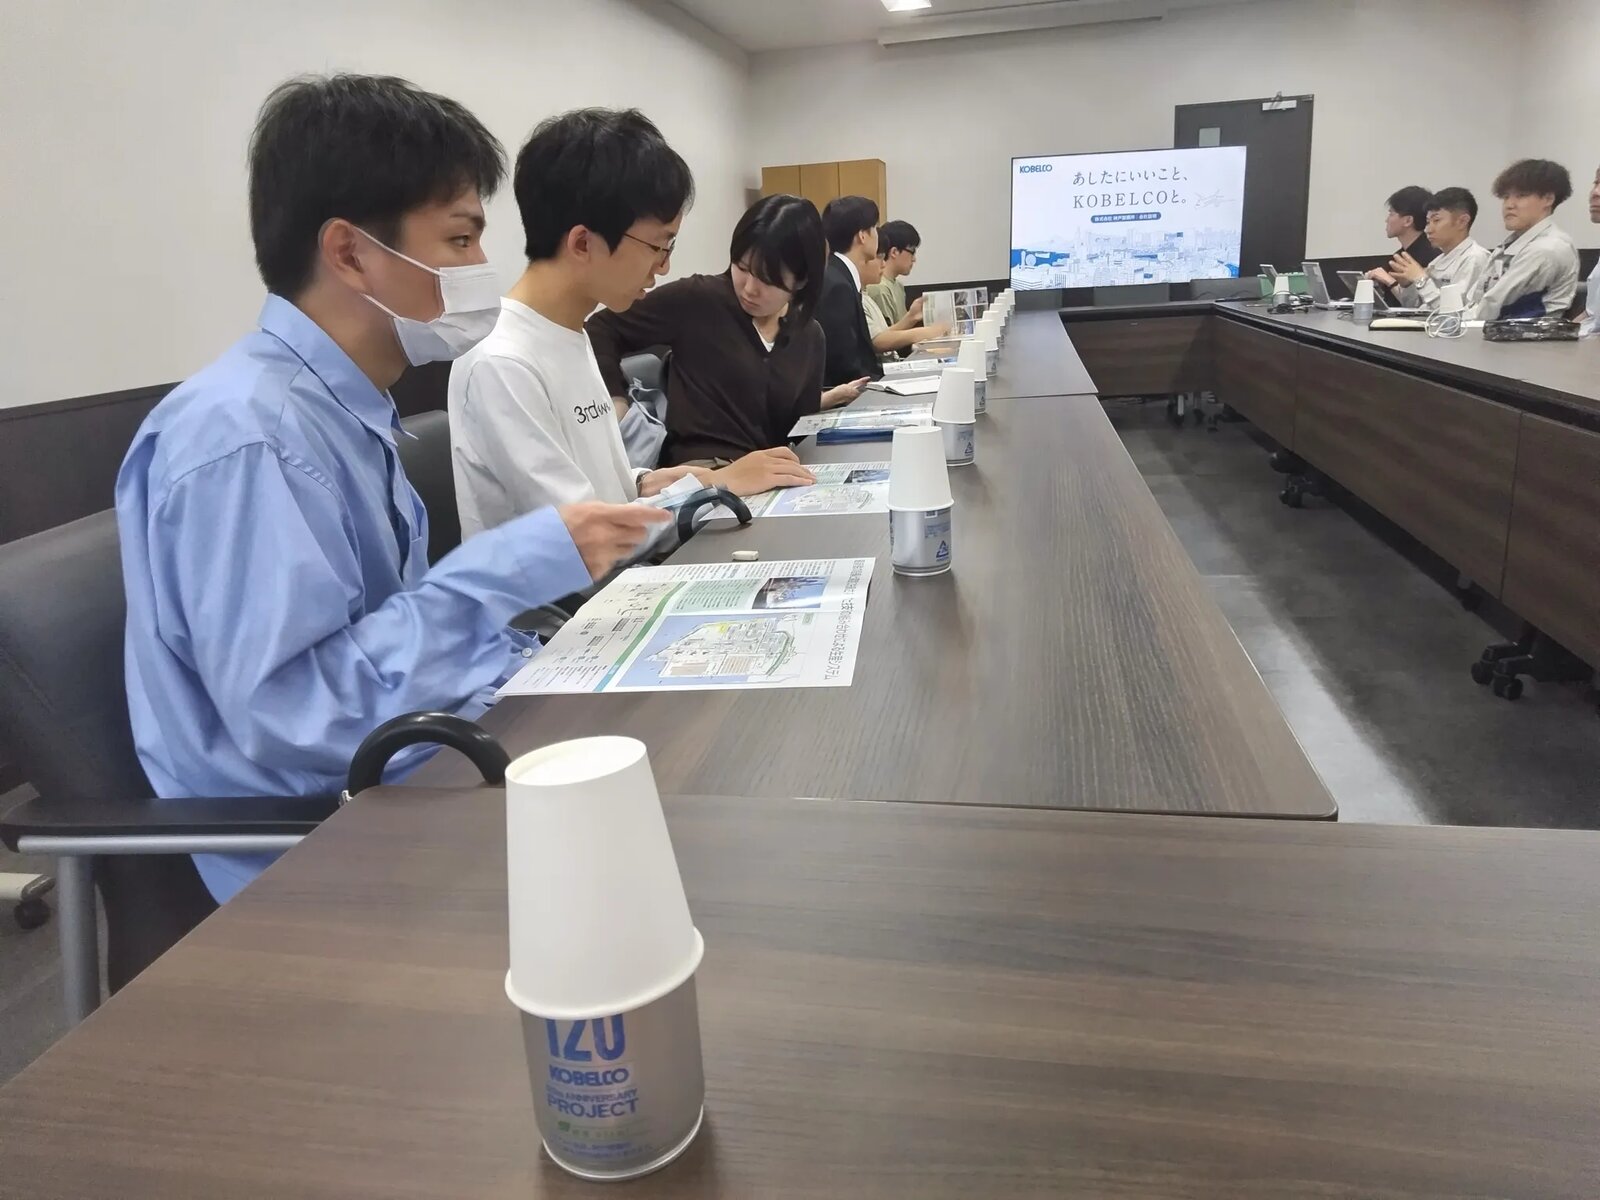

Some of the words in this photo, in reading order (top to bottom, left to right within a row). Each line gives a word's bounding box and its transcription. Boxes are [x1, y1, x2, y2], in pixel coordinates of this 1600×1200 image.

[1019, 164, 1053, 174] KOBELCO
[1072, 166, 1189, 186] あしたにいいこと、
[1072, 189, 1188, 209] KOBELCOと。
[549, 1065, 630, 1086] KOBELCO
[548, 1095, 639, 1118] PROJECT
